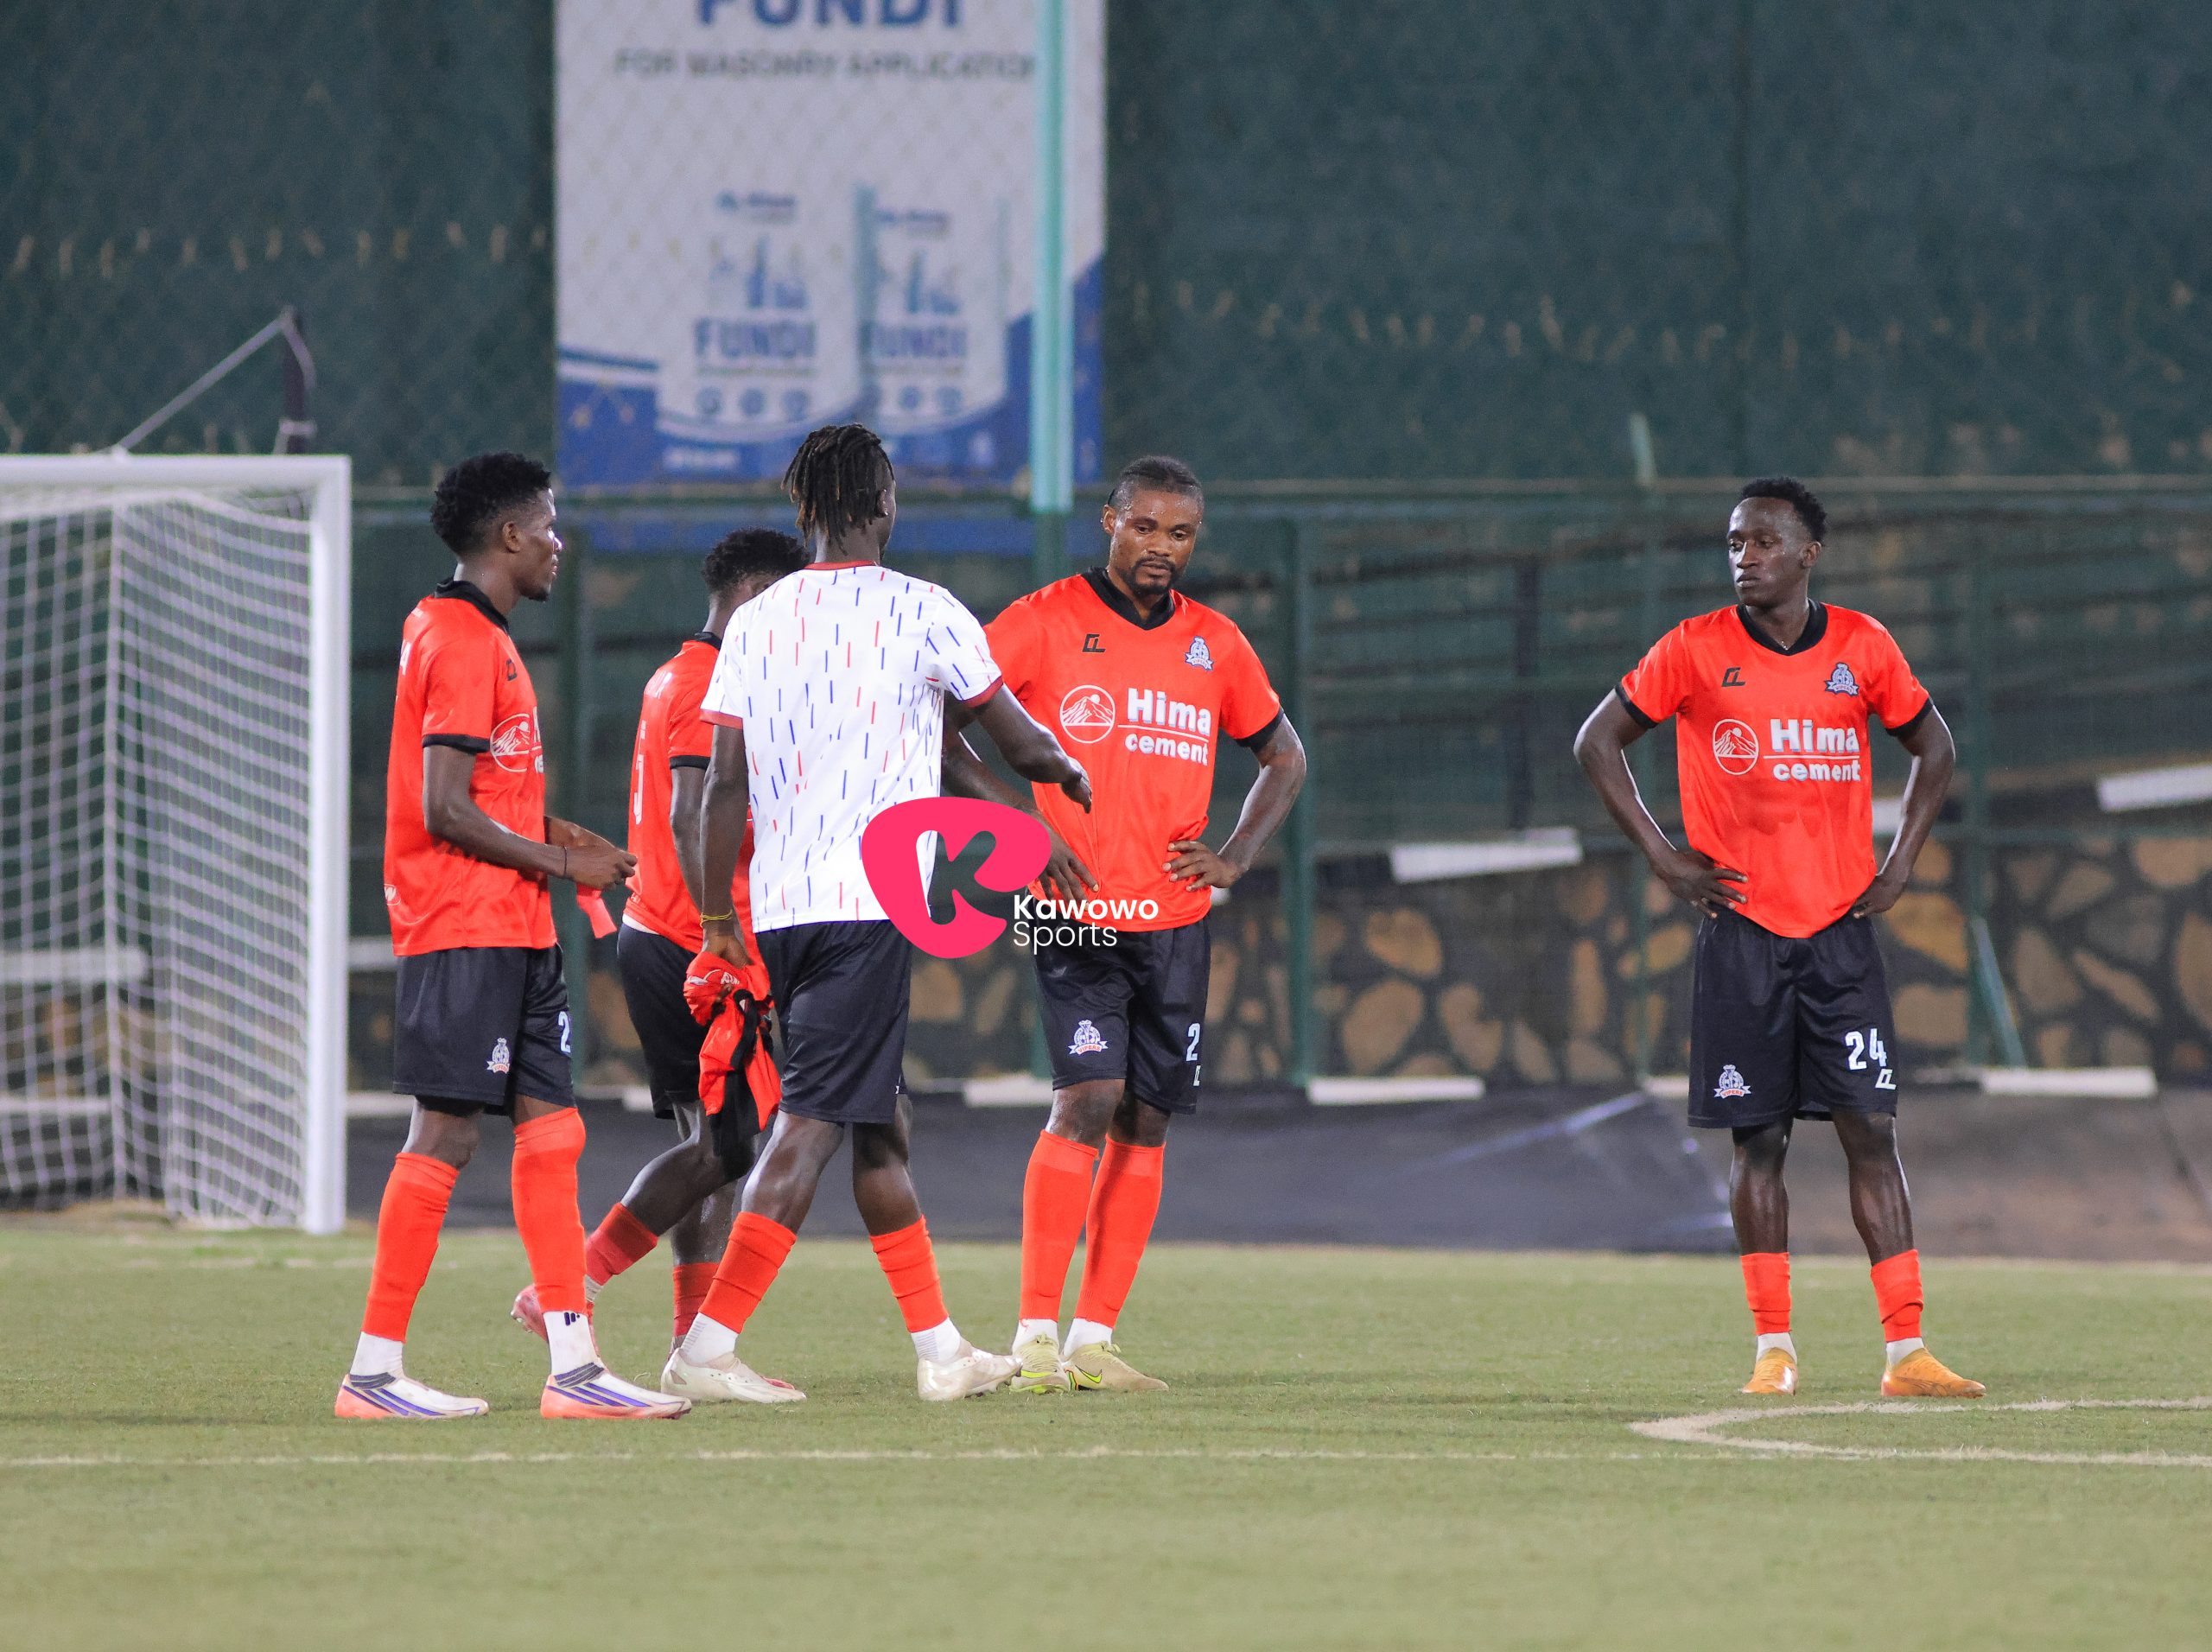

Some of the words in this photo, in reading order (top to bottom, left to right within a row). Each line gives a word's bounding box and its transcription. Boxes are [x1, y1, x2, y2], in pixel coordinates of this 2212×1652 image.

[1127, 688, 1211, 736] Hima
[1125, 733, 1209, 766] cement
[1770, 718, 1860, 753] Hima
[1772, 759, 1861, 782] cement
[1845, 1028, 1888, 1071] 24
